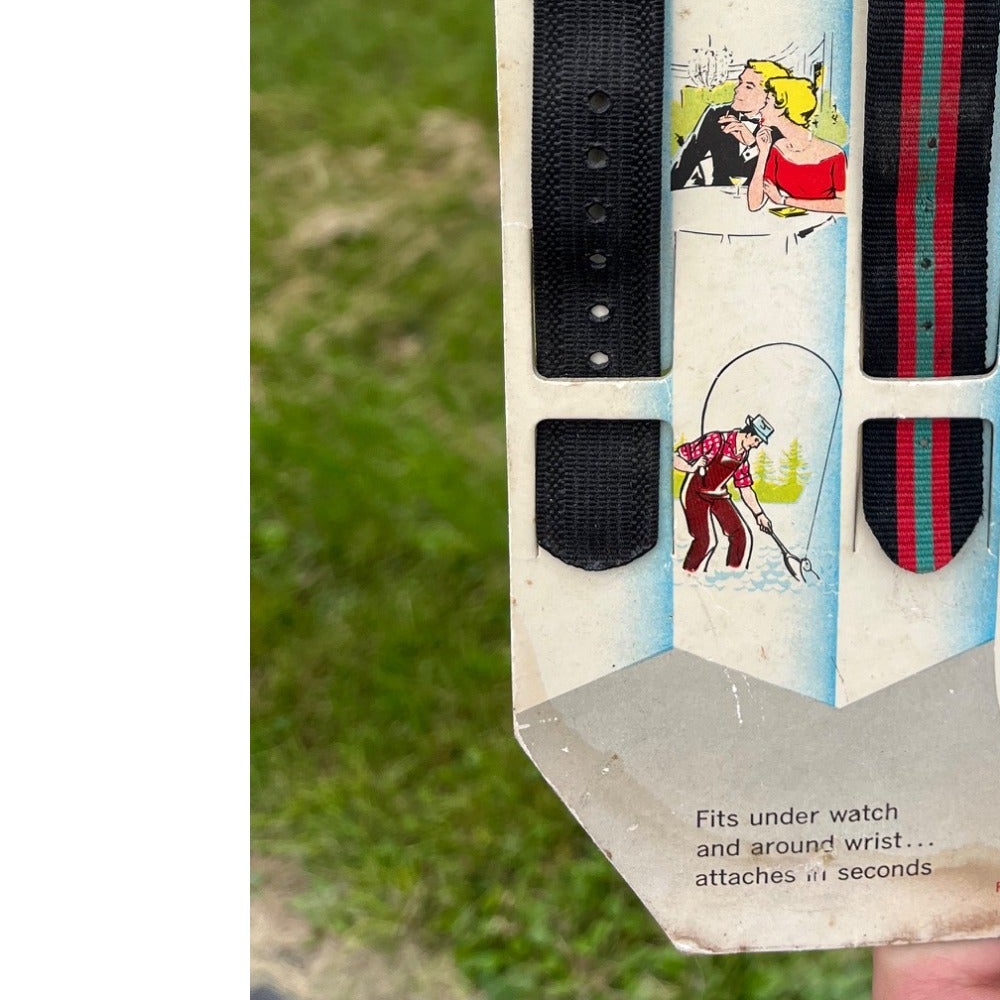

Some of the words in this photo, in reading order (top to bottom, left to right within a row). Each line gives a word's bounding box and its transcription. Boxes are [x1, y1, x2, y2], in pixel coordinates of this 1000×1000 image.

[696, 809, 739, 829] Fits
[750, 806, 820, 827] under
[829, 802, 898, 823] watch
[696, 838, 740, 858] and
[750, 834, 834, 856] around
[844, 831, 934, 852] wrist...
[695, 866, 796, 887] attaches
[837, 858, 932, 881] seconds
